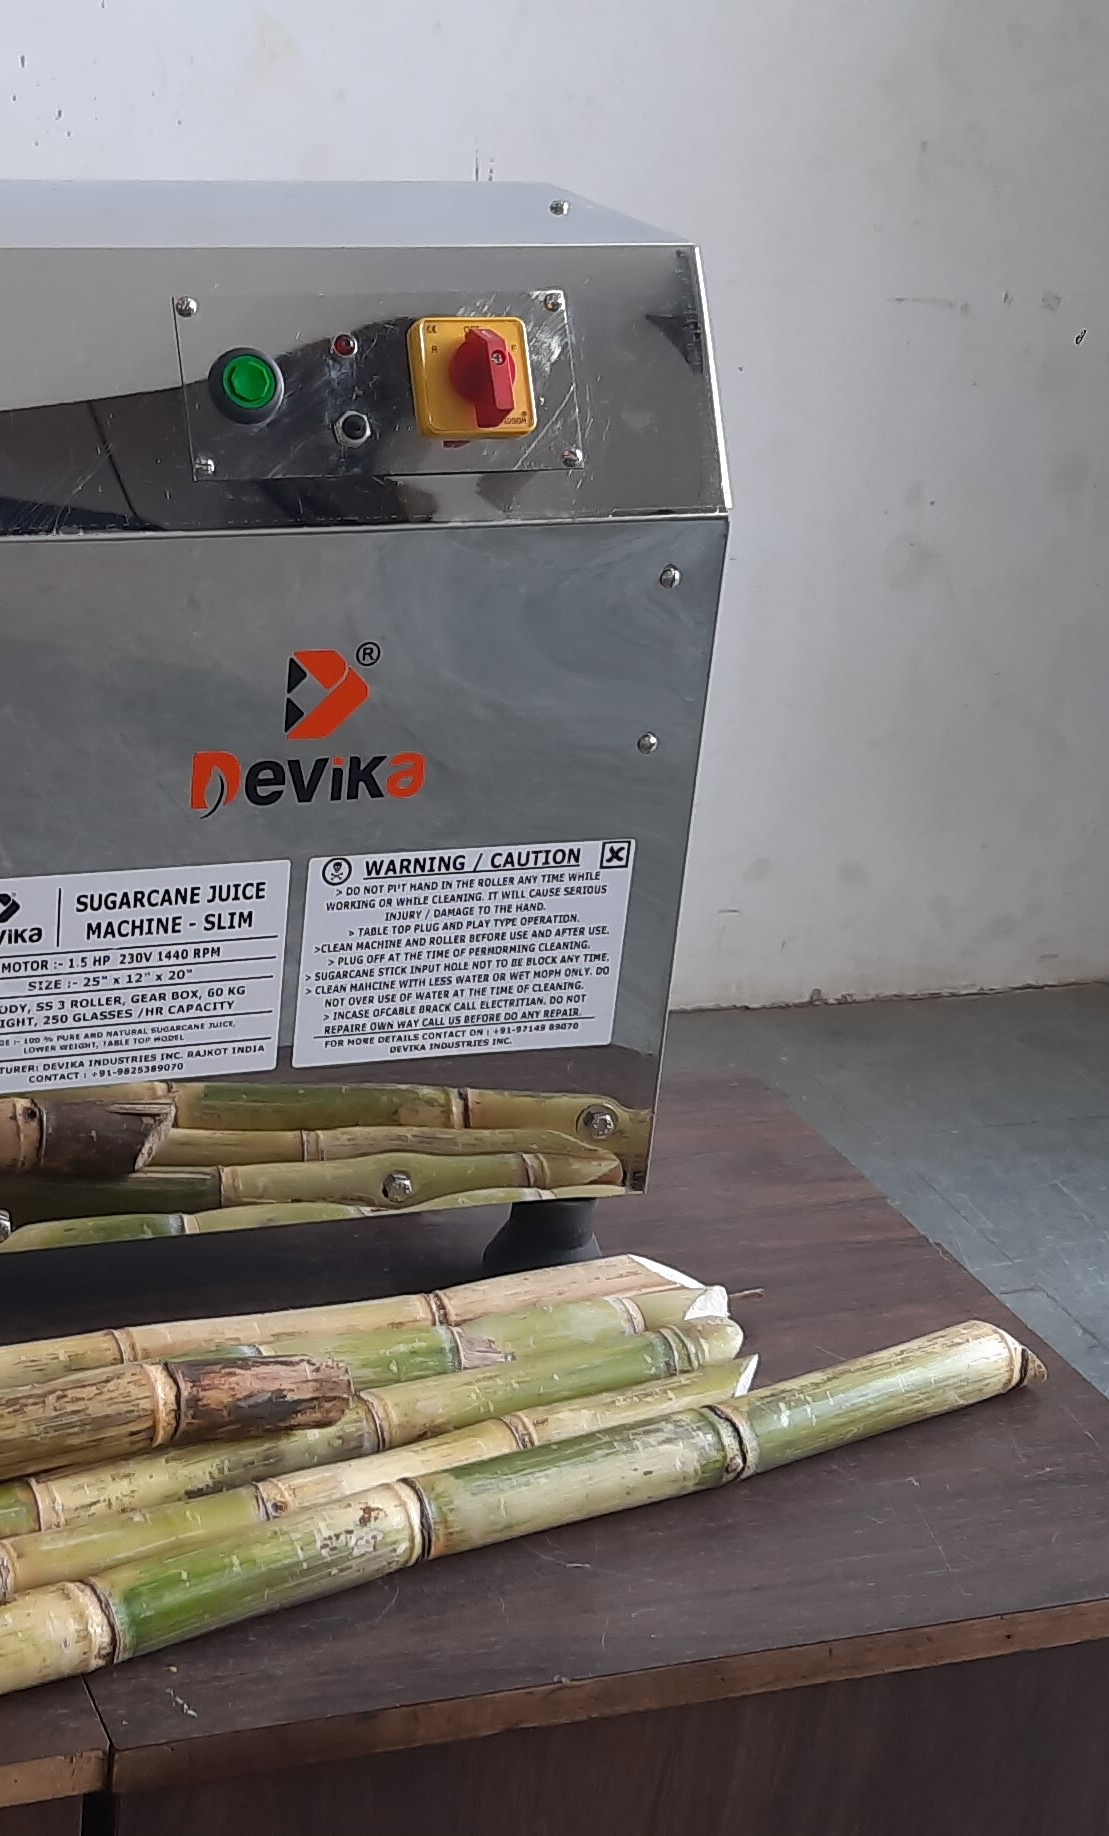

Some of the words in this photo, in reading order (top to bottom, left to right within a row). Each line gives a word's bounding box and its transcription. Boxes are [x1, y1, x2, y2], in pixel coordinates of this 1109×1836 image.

[365, 854, 465, 876] WARNING
[490, 847, 581, 868] CAUTION
[345, 886, 360, 896] DO
[363, 884, 384, 895] NOT
[387, 882, 407, 893] PUT
[409, 880, 438, 892] HAND
[441, 880, 452, 890] IN
[455, 878, 475, 889] THE
[477, 876, 514, 887] ROLLER
[516, 874, 537, 885] ANY
[540, 872, 565, 883] TIME
[568, 870, 600, 881] WHILE
[75, 886, 201, 912] SUGARCANE
[206, 881, 266, 903] JUICE
[325, 898, 375, 911] WORKING
[378, 897, 392, 908] OR
[395, 895, 429, 906] WHILE
[488, 891, 498, 900] IT
[501, 889, 525, 900] WILL
[528, 887, 561, 898] CAUSE
[563, 884, 607, 896] SERIOUS
[86, 915, 182, 940] MACHINE
[203, 910, 253, 931] SLIM
[384, 909, 422, 921] INJURY
[433, 906, 474, 918] DAMAGE
[478, 905, 490, 915] TO
[493, 904, 512, 914] THE
[355, 938, 402, 951] MACHINE
[404, 937, 426, 947] AND
[428, 934, 465, 945] ROLLER
[468, 931, 506, 943] BEFORE
[509, 930, 528, 940] USE
[531, 928, 552, 938] AND
[554, 926, 585, 937] AFTER
[357, 926, 388, 937] TABLE
[391, 924, 411, 934] TOP
[413, 922, 439, 933] PLUG
[441, 921, 463, 931] AND
[465, 919, 491, 929] PLAY
[493, 917, 517, 927] TYPE
[1, 959, 48, 973] MOTOR
[68, 956, 87, 968] 1.5
[92, 954, 110, 966] HP
[119, 951, 152, 964] 230V
[157, 948, 188, 962] 1440
[193, 946, 220, 959] RPM
[314, 968, 374, 981] SUGARCANE
[377, 965, 407, 976] STICK
[409, 963, 441, 974] INPUT
[443, 961, 468, 971] HOLE
[471, 959, 492, 969] NOT
[495, 958, 508, 968] TO
[525, 955, 557, 966] BLOCK
[559, 954, 580, 963] ANY
[337, 955, 363, 965] PLUG
[366, 953, 385, 963] OFF
[387, 952, 401, 962] AT
[404, 950, 423, 961] THE
[425, 949, 450, 959] TIME
[452, 947, 466, 957] OF
[27, 979, 61, 991] SIZE
[314, 983, 347, 995] CLEAN
[349, 980, 396, 992] MAHCINE
[398, 977, 425, 988] WITH
[428, 976, 452, 986] LESS
[455, 973, 489, 984] WATER
[492, 972, 506, 982] OR
[509, 970, 531, 980] WET
[595, 965, 609, 975] DO
[35, 1001, 53, 1012] SS
[57, 1000, 65, 1010] 3
[70, 995, 125, 1008] ROLLER,
[130, 992, 166, 1003] GEAR
[171, 989, 202, 1000] BOX,
[207, 987, 223, 997] 60
[227, 985, 245, 995] KG
[324, 997, 345, 1008] NOT
[348, 995, 374, 1006] OVER
[377, 993, 396, 1003] USE
[399, 992, 412, 1002] OF
[415, 990, 449, 1000] WATER
[451, 988, 464, 997] AT
[469, 987, 487, 997] THE
[489, 985, 513, 995] TIME
[516, 984, 529, 993] OF
[332, 1009, 369, 1020] INCASE
[372, 1005, 415, 1017] OFCABLE
[453, 1001, 476, 1011] CALL
[549, 995, 563, 1004] DO
[565, 993, 586, 1003] NOT
[42, 1014, 68, 1025] 250
[72, 1008, 132, 1022] GLASSES
[137, 1006, 163, 1018] /HR
[167, 1000, 234, 1014] CAPACITY
[324, 1022, 367, 1034] REPAIRE
[369, 1021, 393, 1031] OWN
[396, 1018, 419, 1029] WAY
[421, 1017, 445, 1027] CALL
[448, 1015, 461, 1025] US
[463, 1012, 501, 1023] BEFORE
[503, 1011, 518, 1021] DO
[520, 1010, 541, 1019] ANY
[82, 1030, 104, 1040] AND
[149, 1021, 205, 1034] SUGARCANE
[323, 1038, 345, 1049] FOR
[376, 1032, 420, 1044] DETAILS
[420, 1028, 467, 1041] CONTACT
[468, 1027, 484, 1037] ON
[88, 1053, 156, 1067] INDUSTRIES
[187, 1047, 228, 1058] RAJKOT
[231, 1044, 264, 1054] INDIA
[427, 1037, 490, 1051] INDUSTRIES
[28, 1071, 79, 1083] CONTACT
